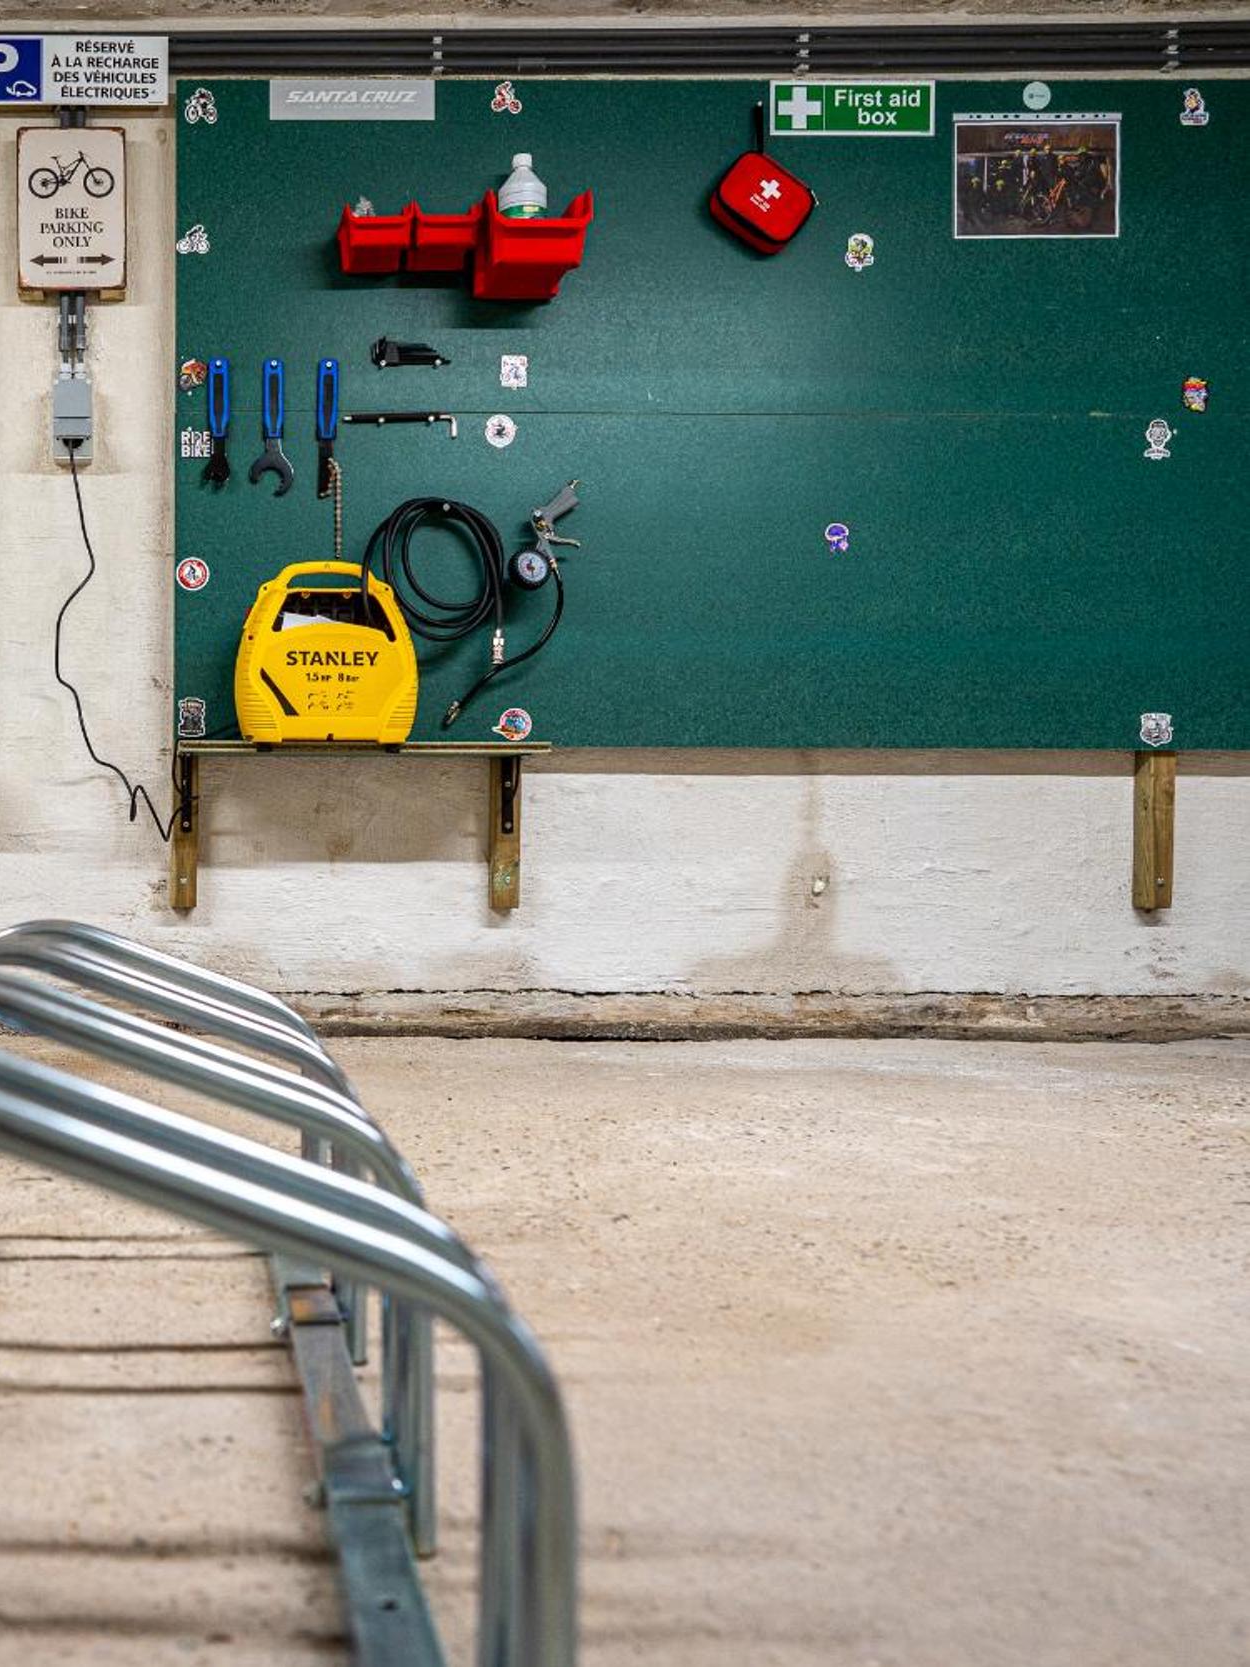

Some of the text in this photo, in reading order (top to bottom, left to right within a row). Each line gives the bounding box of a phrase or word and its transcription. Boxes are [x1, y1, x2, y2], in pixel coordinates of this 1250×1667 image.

[75, 40, 135, 54] RÉSERVÉ
[51, 54, 160, 69] À LA RECHARGE
[53, 70, 157, 84] DES VÉHICULES
[60, 85, 149, 99] ÉLECTRIQUES
[286, 90, 418, 103] SANTA CRUZ
[834, 89, 921, 107] First aid
[857, 108, 898, 125] box
[55, 207, 90, 219] BIKE
[40, 221, 104, 234] PARKING
[52, 236, 92, 248] ONLY
[286, 651, 379, 667] STANLEY
